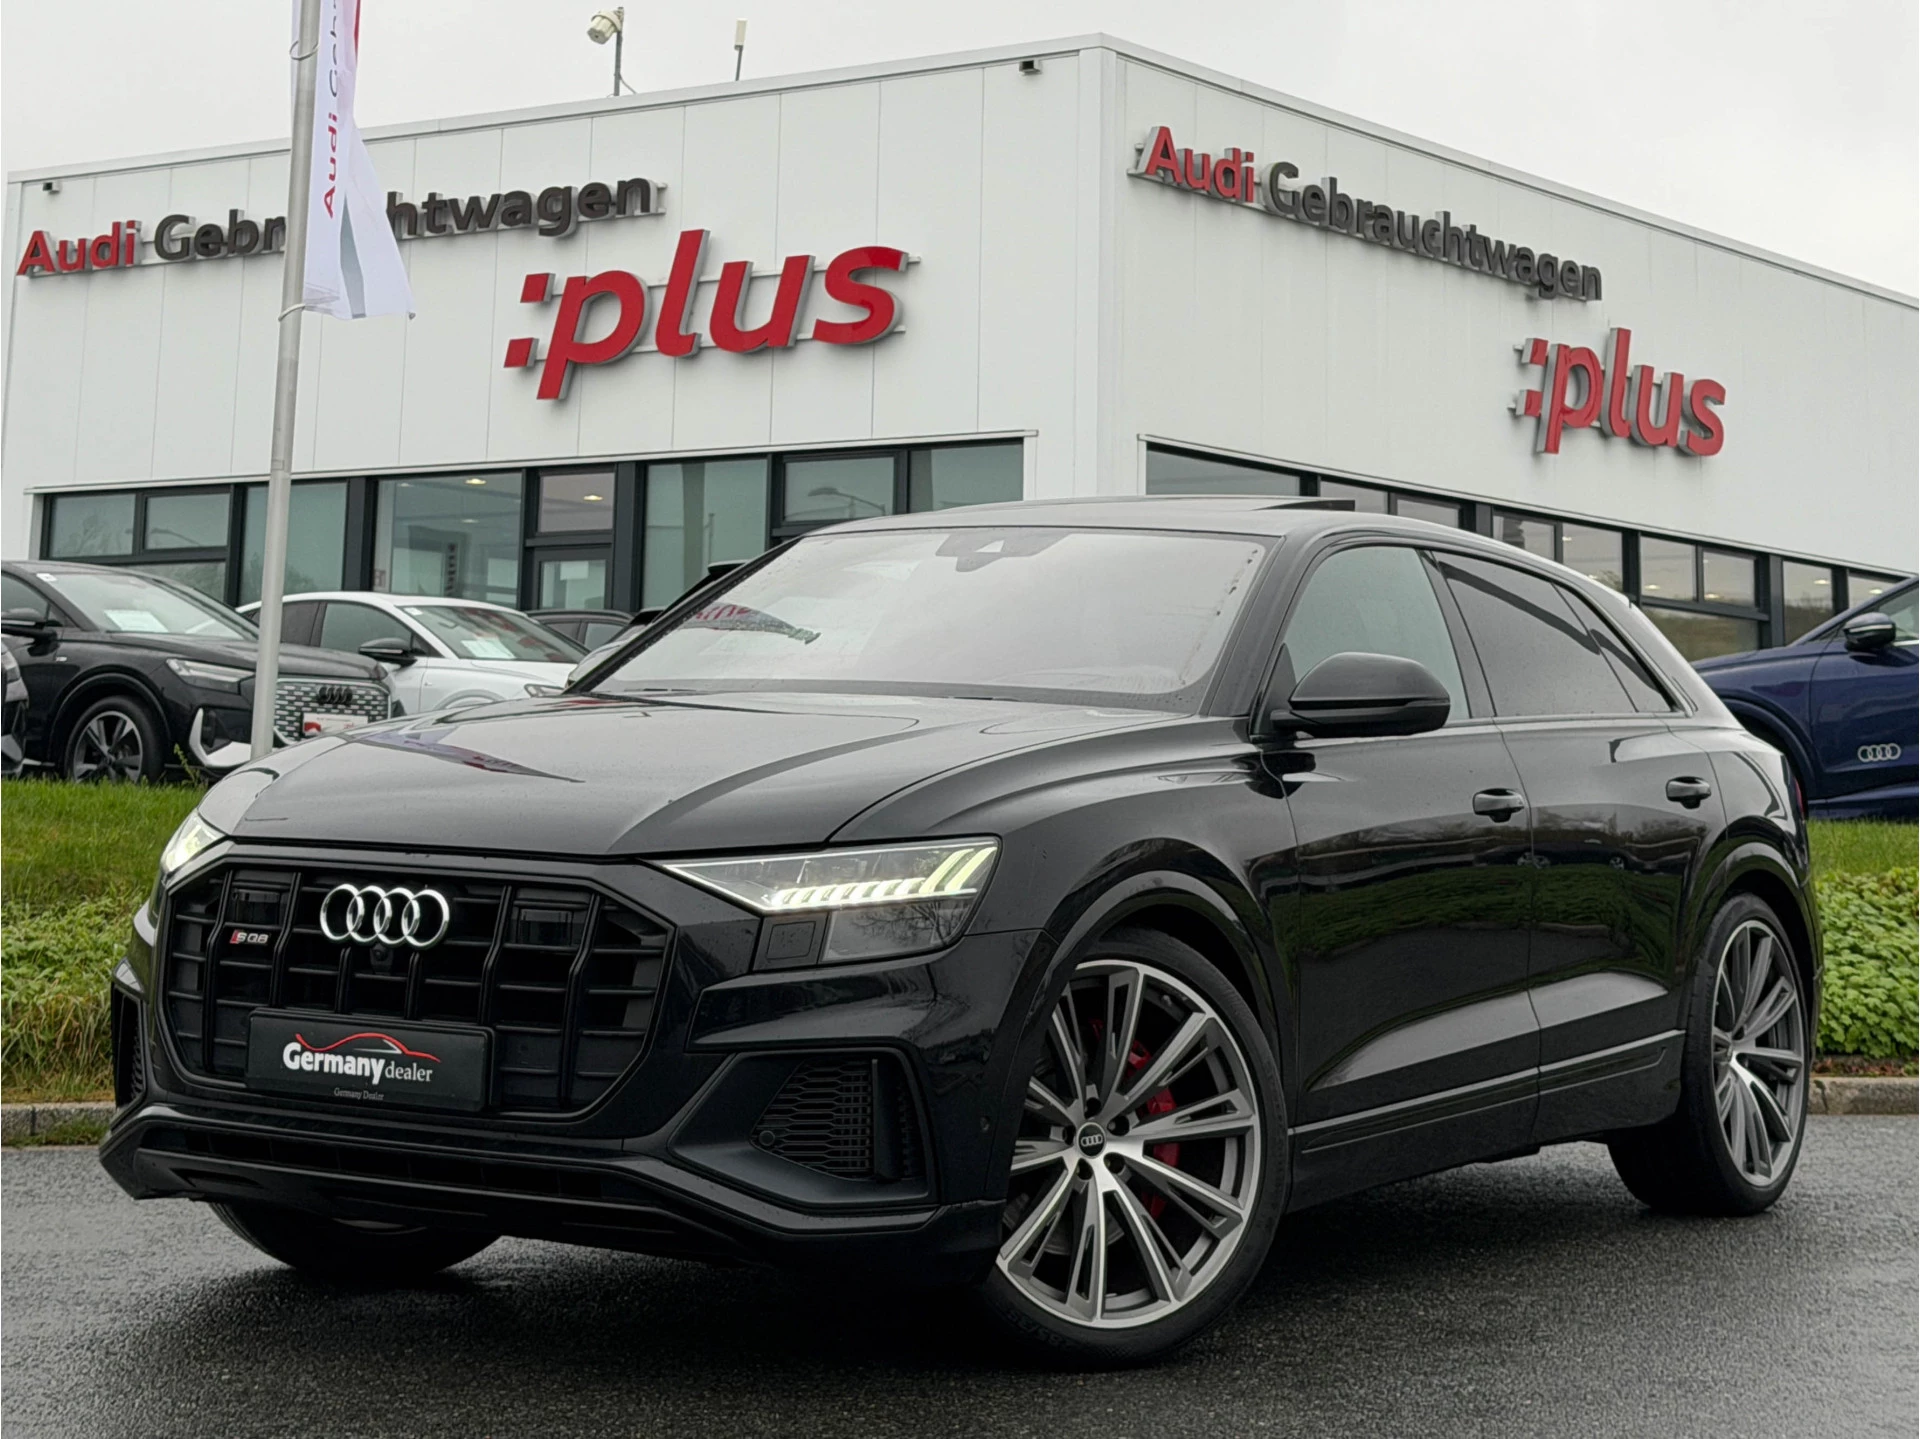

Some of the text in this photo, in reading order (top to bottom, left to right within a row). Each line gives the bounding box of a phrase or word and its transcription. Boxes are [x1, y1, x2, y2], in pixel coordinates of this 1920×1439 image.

[323, 112, 338, 219] Audi
[1144, 126, 1602, 300] Audi Gebrauchtwagen
[16, 177, 651, 276] Audi Gebrhtwagen
[283, 1041, 433, 1085] Germany dealer
